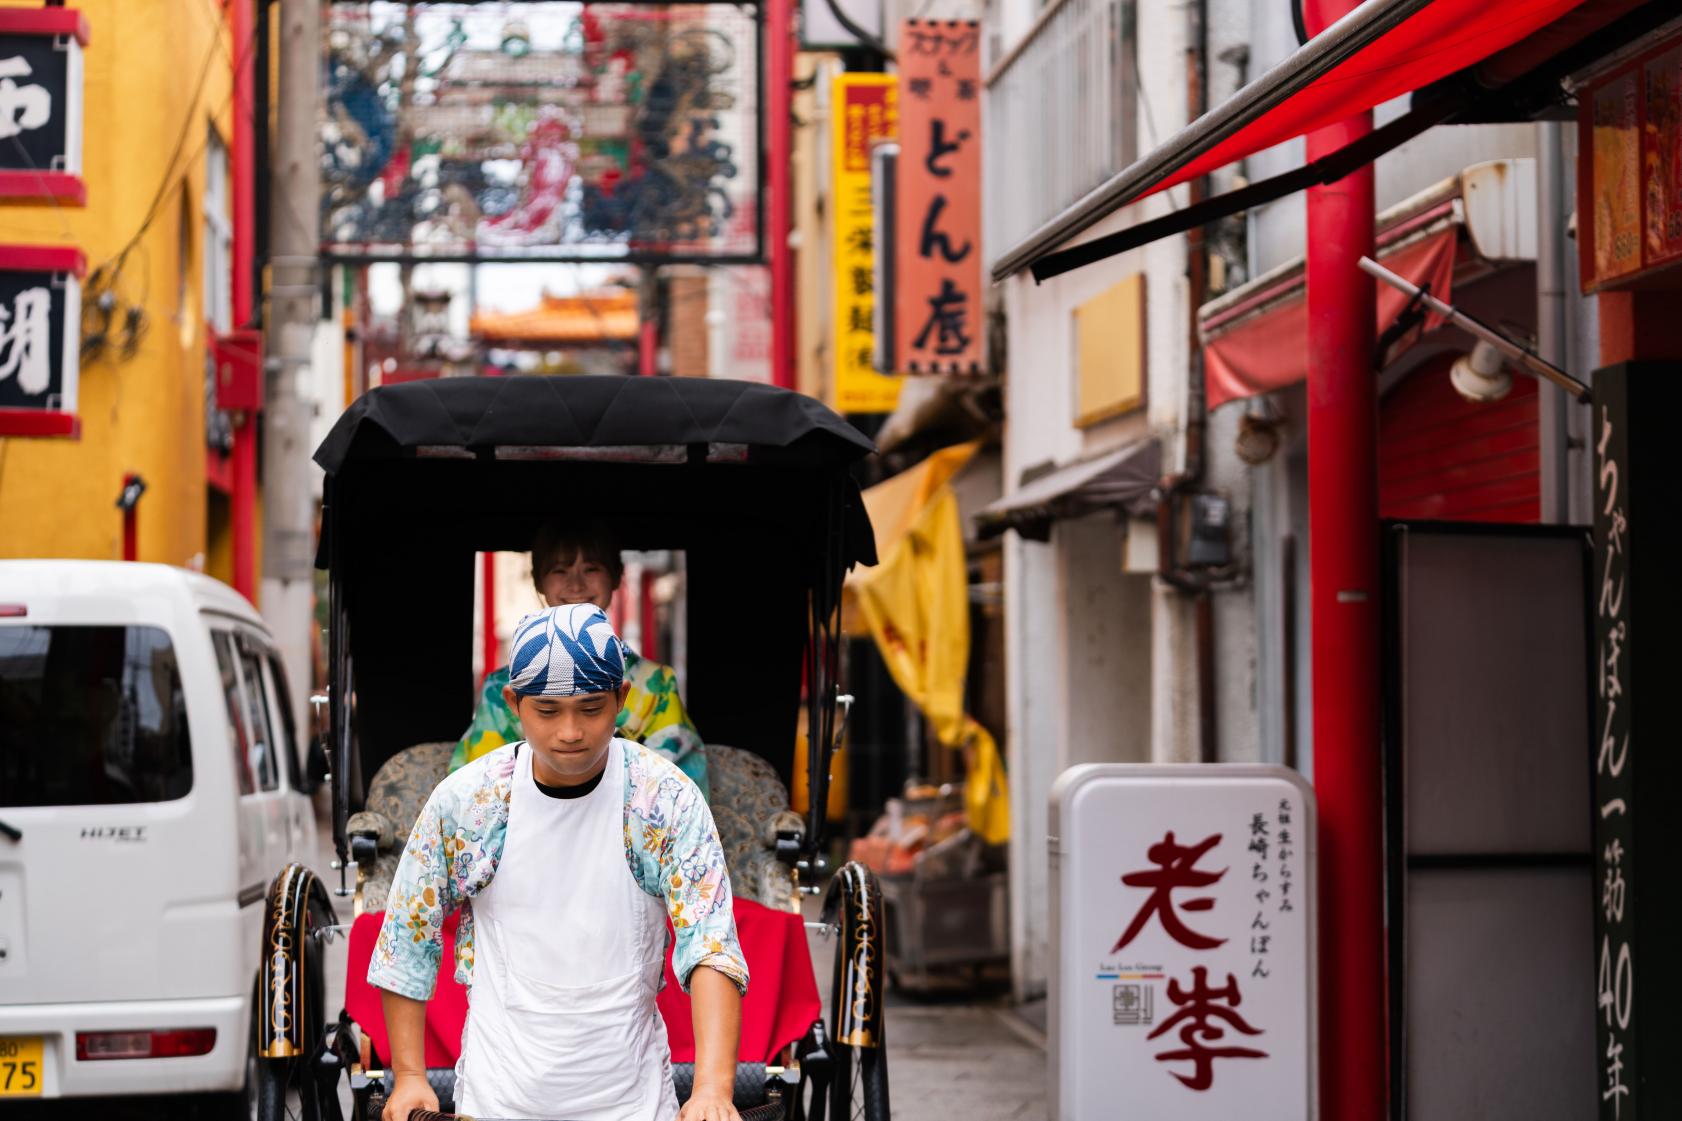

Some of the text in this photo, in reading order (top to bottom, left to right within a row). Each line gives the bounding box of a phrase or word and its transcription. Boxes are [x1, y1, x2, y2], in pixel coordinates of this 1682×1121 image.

[912, 118, 972, 356] どん底
[80, 826, 147, 840] HIJET
[1248, 812, 1270, 978] 長崎ちゃんぽん
[3, 1062, 36, 1090] 75
